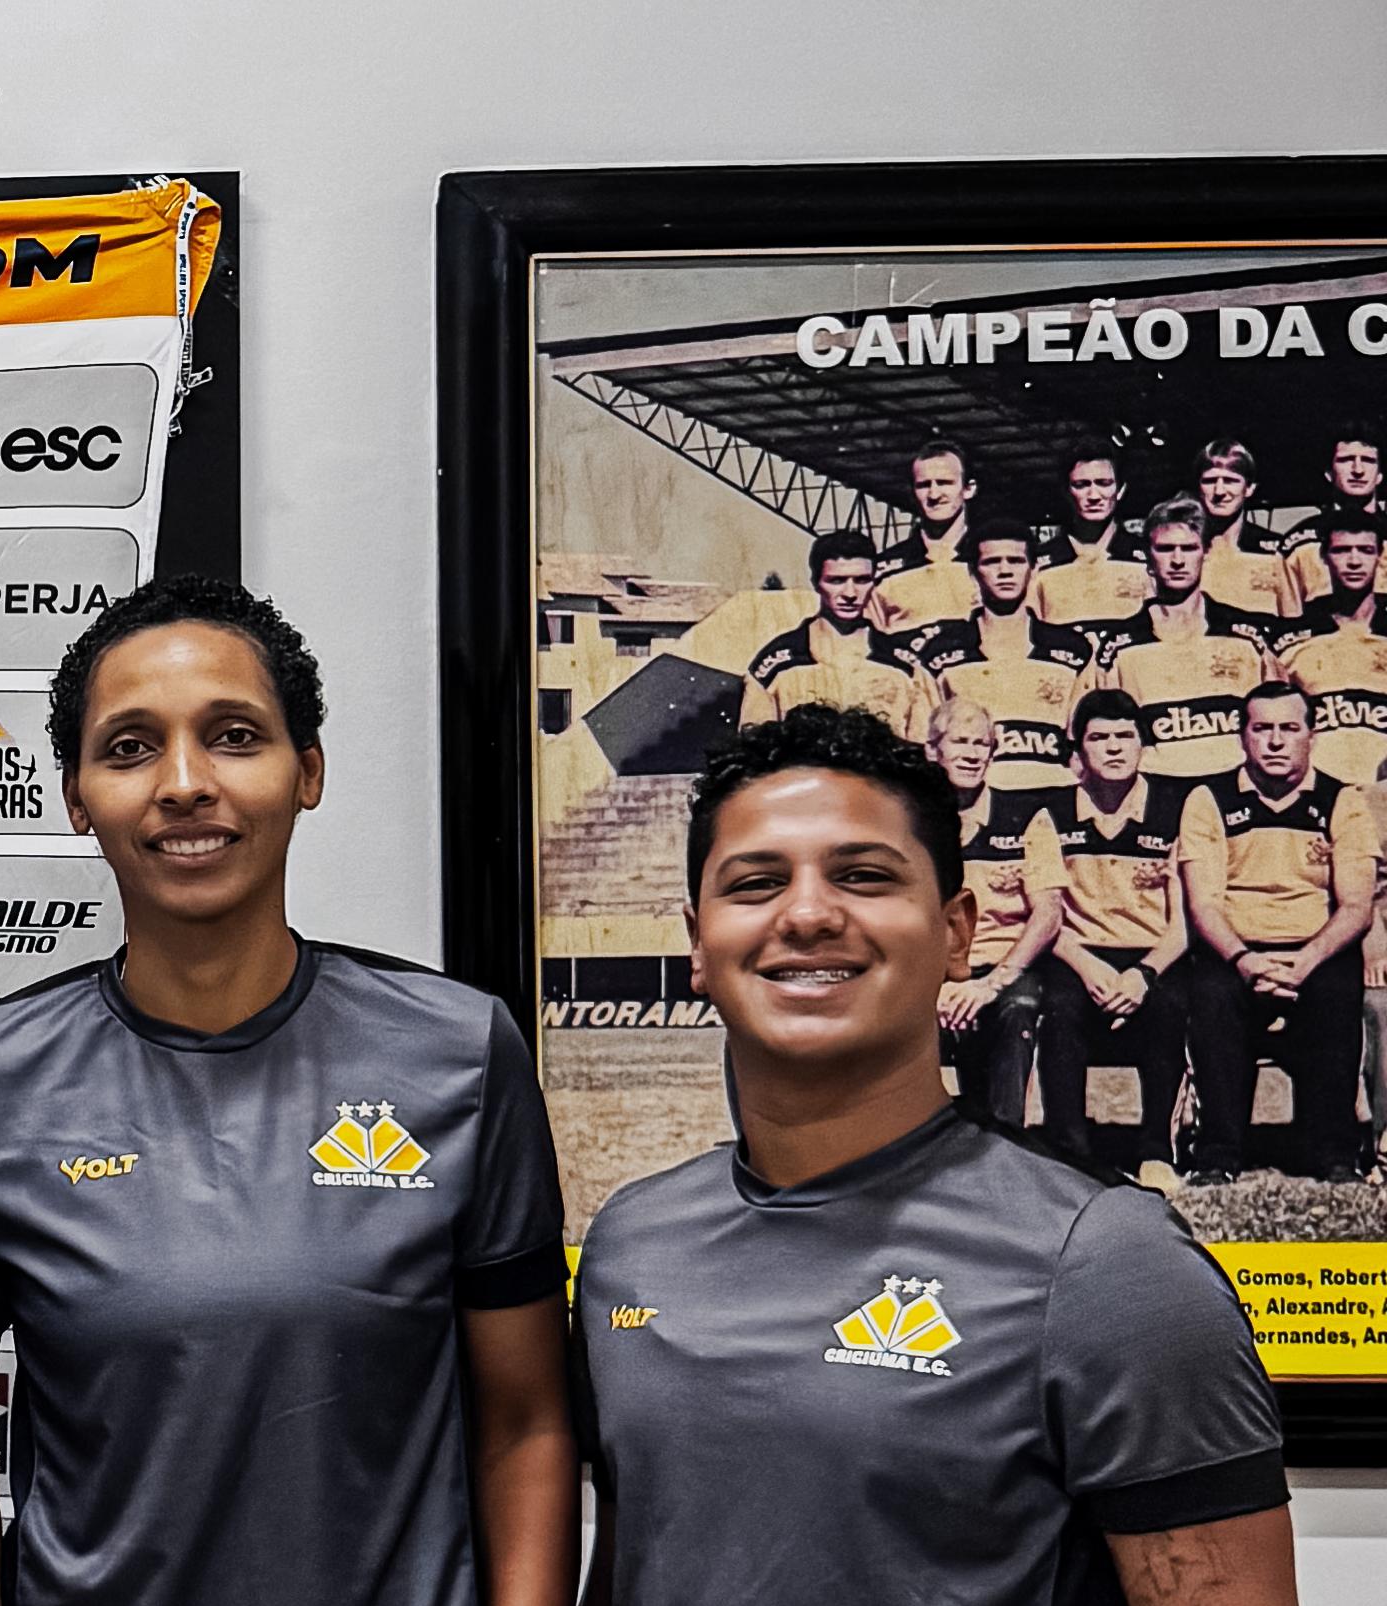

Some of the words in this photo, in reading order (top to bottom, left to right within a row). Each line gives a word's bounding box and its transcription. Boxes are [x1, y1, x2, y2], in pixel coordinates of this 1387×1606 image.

[796, 297, 1188, 369] CAMPEÃO
[1219, 305, 1324, 359] DA
[542, 1001, 725, 1027] NTORAMA
[60, 1152, 140, 1185] VOLT
[1237, 1268, 1313, 1289] Gomes,
[611, 1304, 659, 1331] VOLT
[1267, 1296, 1375, 1319] Alexandre,
[1253, 1326, 1357, 1348] ernandes,
